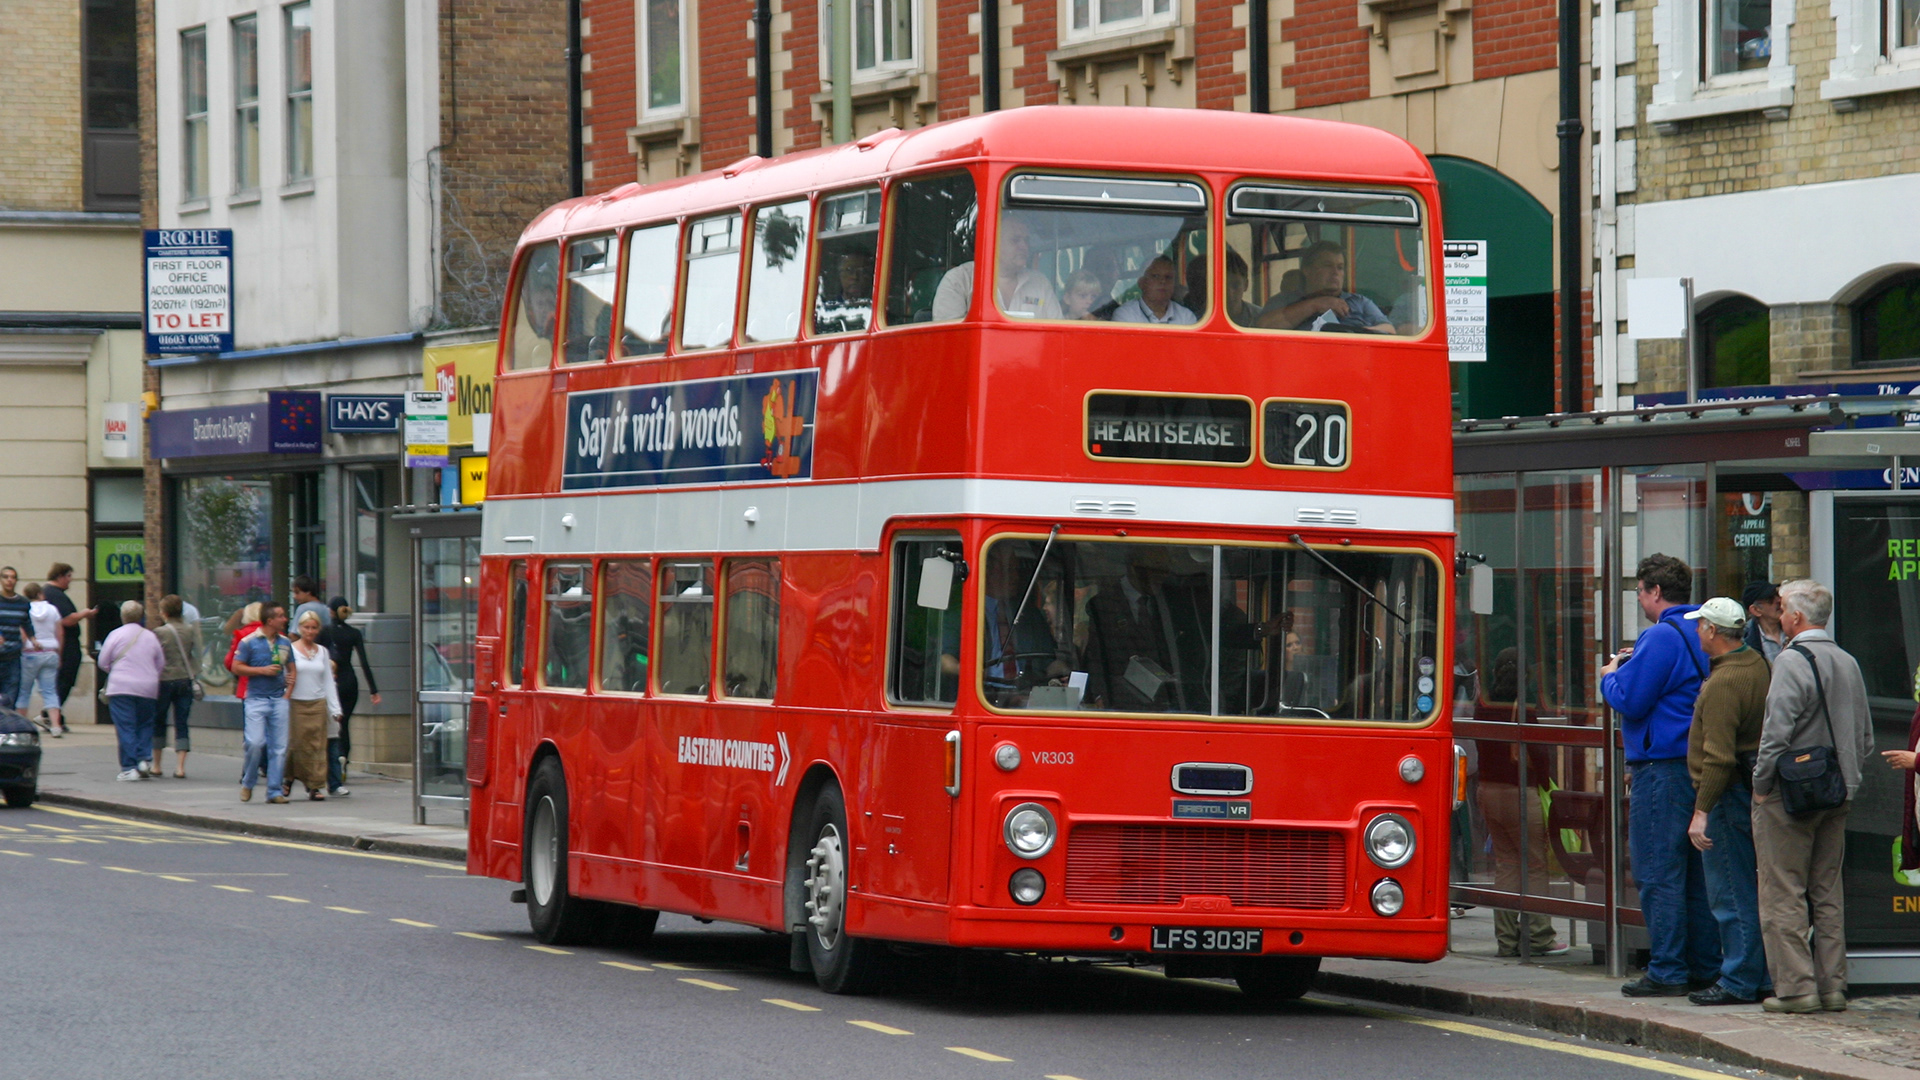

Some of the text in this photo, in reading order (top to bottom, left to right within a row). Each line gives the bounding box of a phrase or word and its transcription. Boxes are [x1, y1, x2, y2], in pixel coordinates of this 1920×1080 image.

[158, 229, 219, 246] ROCHE
[152, 260, 222, 270] FIRST FLOOR
[168, 273, 208, 282] OFFICE
[1445, 277, 1470, 285] orwich
[150, 284, 227, 295] ACCOMMODATION
[153, 313, 224, 329] TO LET
[158, 333, 220, 345] 01603 619876
[437, 369, 455, 395] The
[1877, 384, 1901, 396] The
[337, 401, 390, 420] HAYS
[193, 416, 222, 440] Bradford
[228, 415, 252, 444] Bingley
[578, 389, 742, 469] Say it with words.
[1093, 419, 1235, 447] HEARTSEASE
[1293, 414, 1347, 466] 20
[470, 471, 483, 481] W
[1883, 467, 1920, 484] CEN
[1741, 519, 1766, 529] APPEAL
[1734, 533, 1766, 547] CENTRE
[1888, 539, 1920, 557] RE
[1888, 561, 1920, 580] AP
[678, 736, 775, 772] EASTERN COUNTIES
[1032, 751, 1075, 765] VR303
[1177, 804, 1248, 815] BRISTOL VR
[1892, 896, 1920, 912] EN
[1153, 928, 1261, 951] LFS 303F
